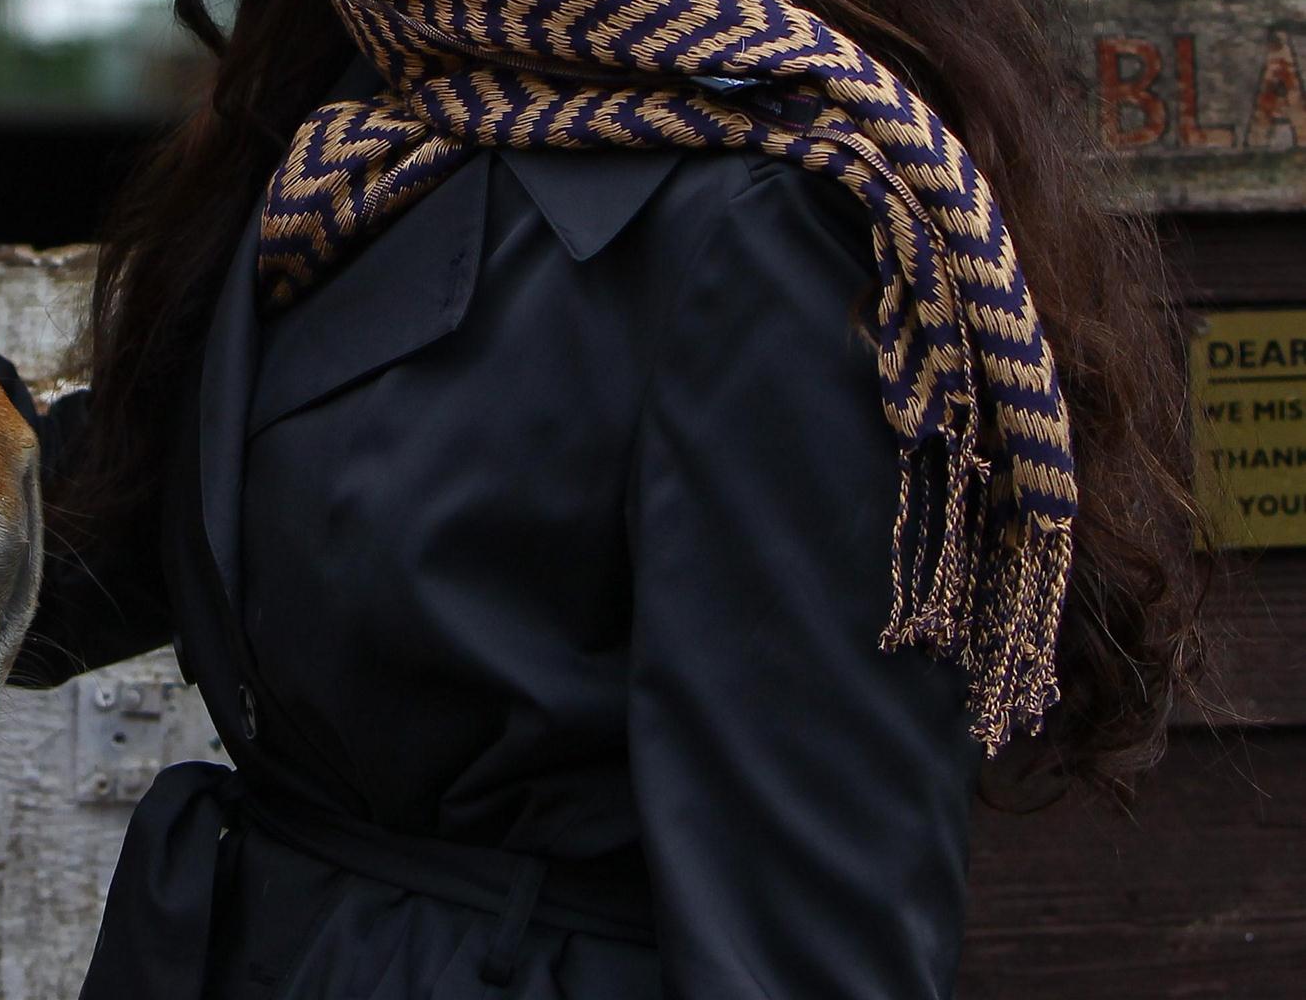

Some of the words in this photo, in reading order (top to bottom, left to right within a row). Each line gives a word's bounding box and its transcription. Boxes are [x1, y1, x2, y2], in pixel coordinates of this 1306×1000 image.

[1096, 31, 1306, 147] BLA
[1207, 338, 1306, 369] DEAR
[1253, 399, 1303, 421] MIS
[1238, 493, 1306, 516] YOU
